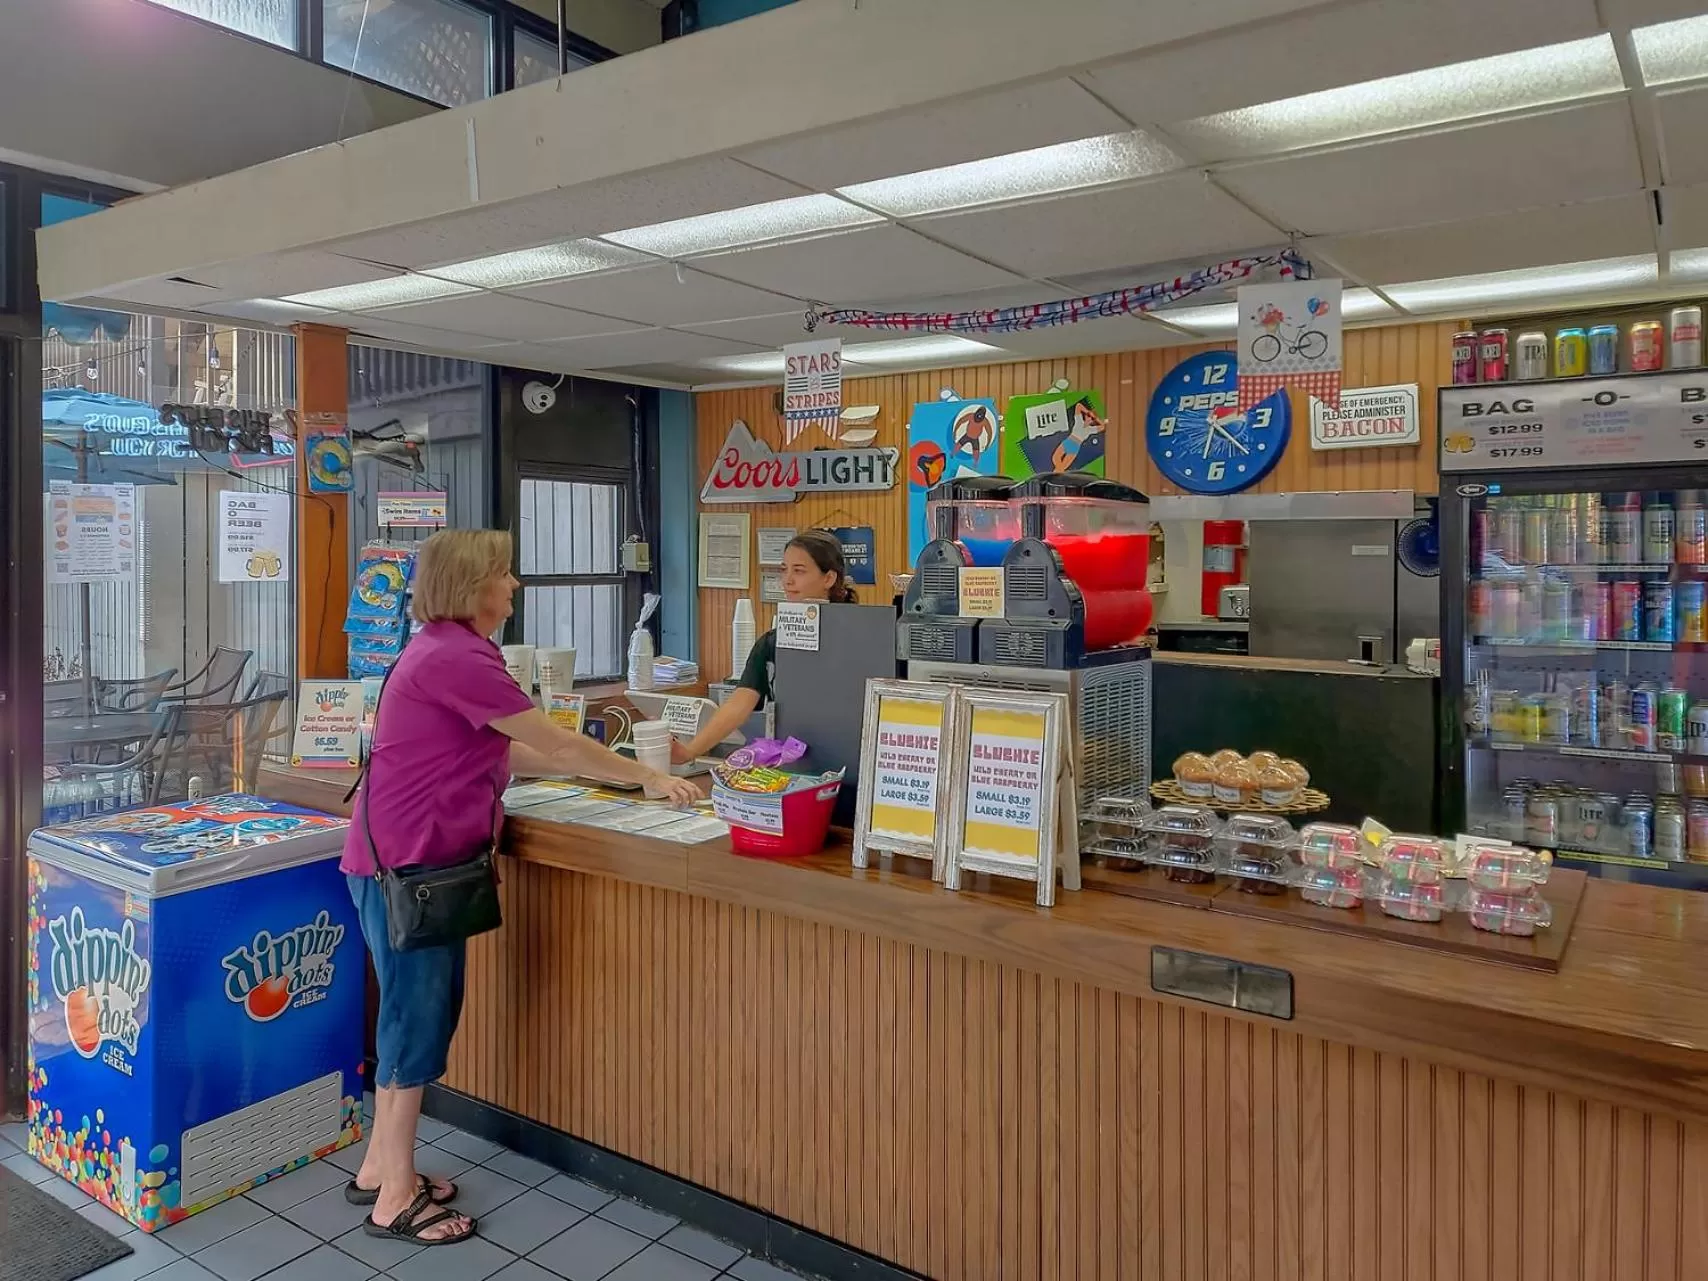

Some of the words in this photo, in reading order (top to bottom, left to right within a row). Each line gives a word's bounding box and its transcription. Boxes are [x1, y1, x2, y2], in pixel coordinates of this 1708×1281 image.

[1524, 345, 1546, 361] IPA
[787, 351, 840, 375] STARS
[1202, 364, 1228, 385] 12
[786, 390, 839, 409] STRIPES
[1178, 390, 1240, 412] PEPS
[1350, 400, 1358, 408] OF
[1359, 396, 1405, 407] EMERGENCY:
[1462, 398, 1535, 417] BAG
[1036, 411, 1057, 428] Lite
[1252, 408, 1272, 428] 3
[1322, 410, 1353, 421] PLEASE
[1354, 406, 1406, 419] ADMINISTER
[1158, 416, 1176, 436] 9
[1322, 417, 1405, 439] BACON
[1488, 423, 1543, 435] $12.99
[712, 447, 801, 489] Coors
[806, 453, 893, 485] LIGHT
[1207, 461, 1225, 481] 6
[779, 616, 807, 625] MILITARY
[783, 624, 815, 633] VETERANS
[330, 725, 357, 734] Candy
[897, 753, 924, 765] CHERRY
[973, 765, 992, 775] WILD
[993, 767, 1024, 778] CHERRY
[1026, 770, 1037, 779] OR
[881, 775, 909, 787] SMALL
[910, 779, 930, 790] $3.19
[881, 789, 907, 801] LARGE
[975, 790, 1006, 803] SMALL
[1008, 794, 1032, 806] $3.19
[974, 805, 1004, 817] LARGE
[1005, 809, 1031, 821] $3.59
[49, 908, 149, 1004] dippin'
[224, 912, 343, 1000] dippin'
[288, 964, 332, 995] dots
[293, 991, 327, 1008] CREAM
[98, 996, 137, 1047] dots
[109, 1044, 125, 1062] ICE
[102, 1053, 133, 1078] CREAM
